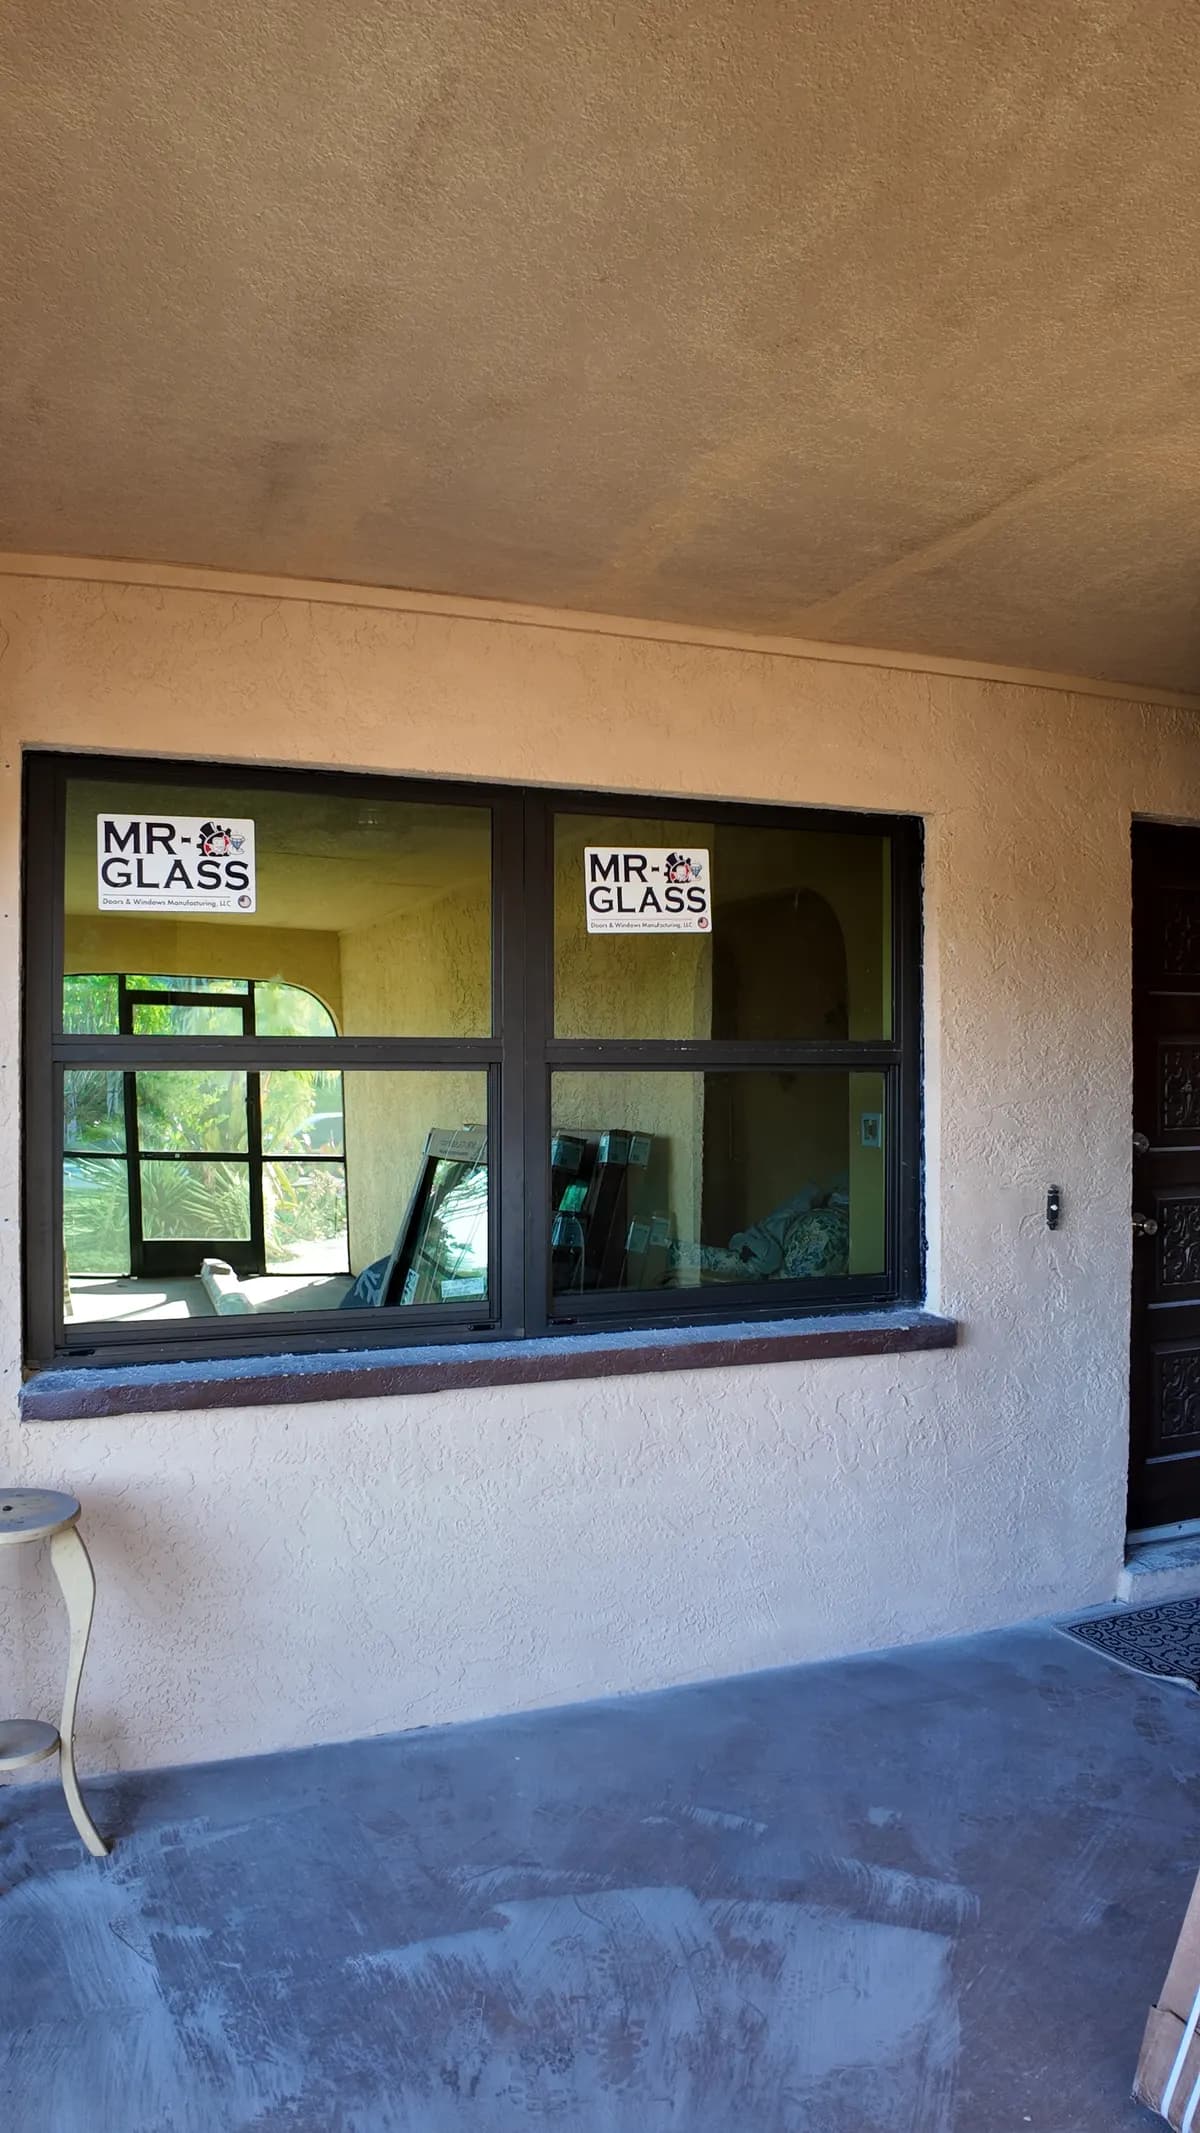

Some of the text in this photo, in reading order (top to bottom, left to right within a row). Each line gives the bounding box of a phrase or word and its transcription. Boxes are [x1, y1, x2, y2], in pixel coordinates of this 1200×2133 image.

[101, 857, 250, 891] GLASS
[133, 898, 166, 906] Windows
[588, 886, 707, 913] GLASS
